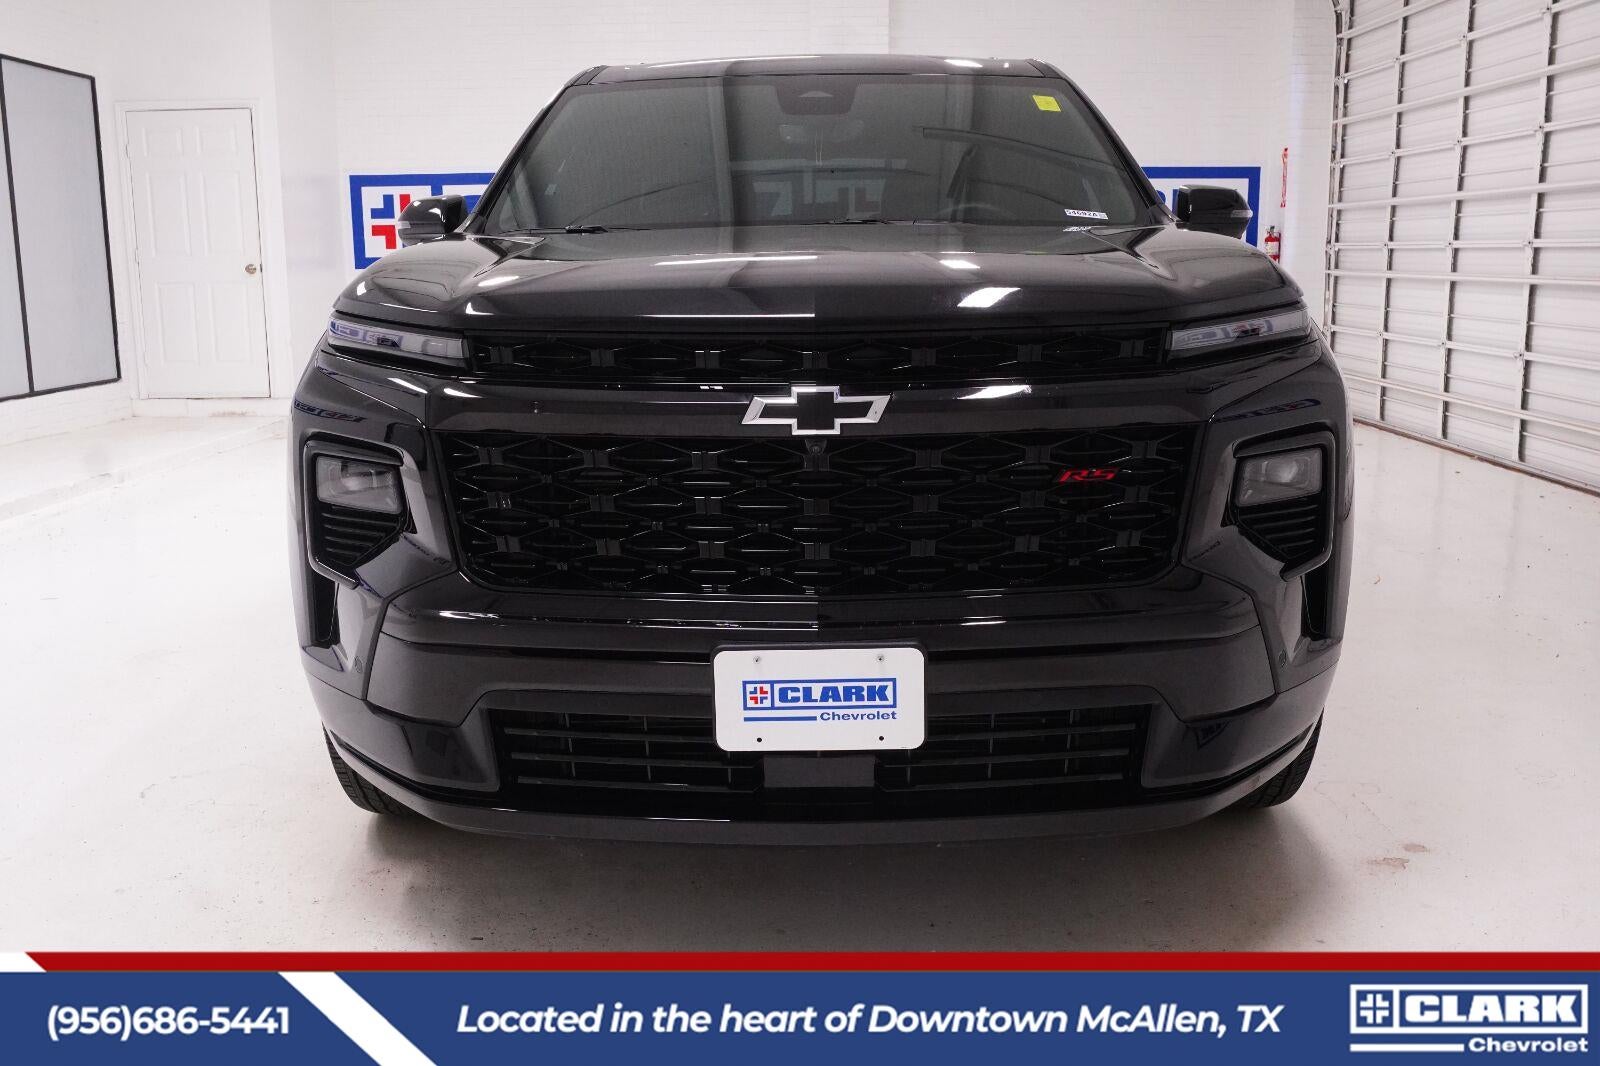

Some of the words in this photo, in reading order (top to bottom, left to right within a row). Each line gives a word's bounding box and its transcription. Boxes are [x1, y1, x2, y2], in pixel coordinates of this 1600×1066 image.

[1059, 468, 1117, 483] RS
[778, 685, 889, 704] CLARK
[819, 710, 897, 721] Chevrolet
